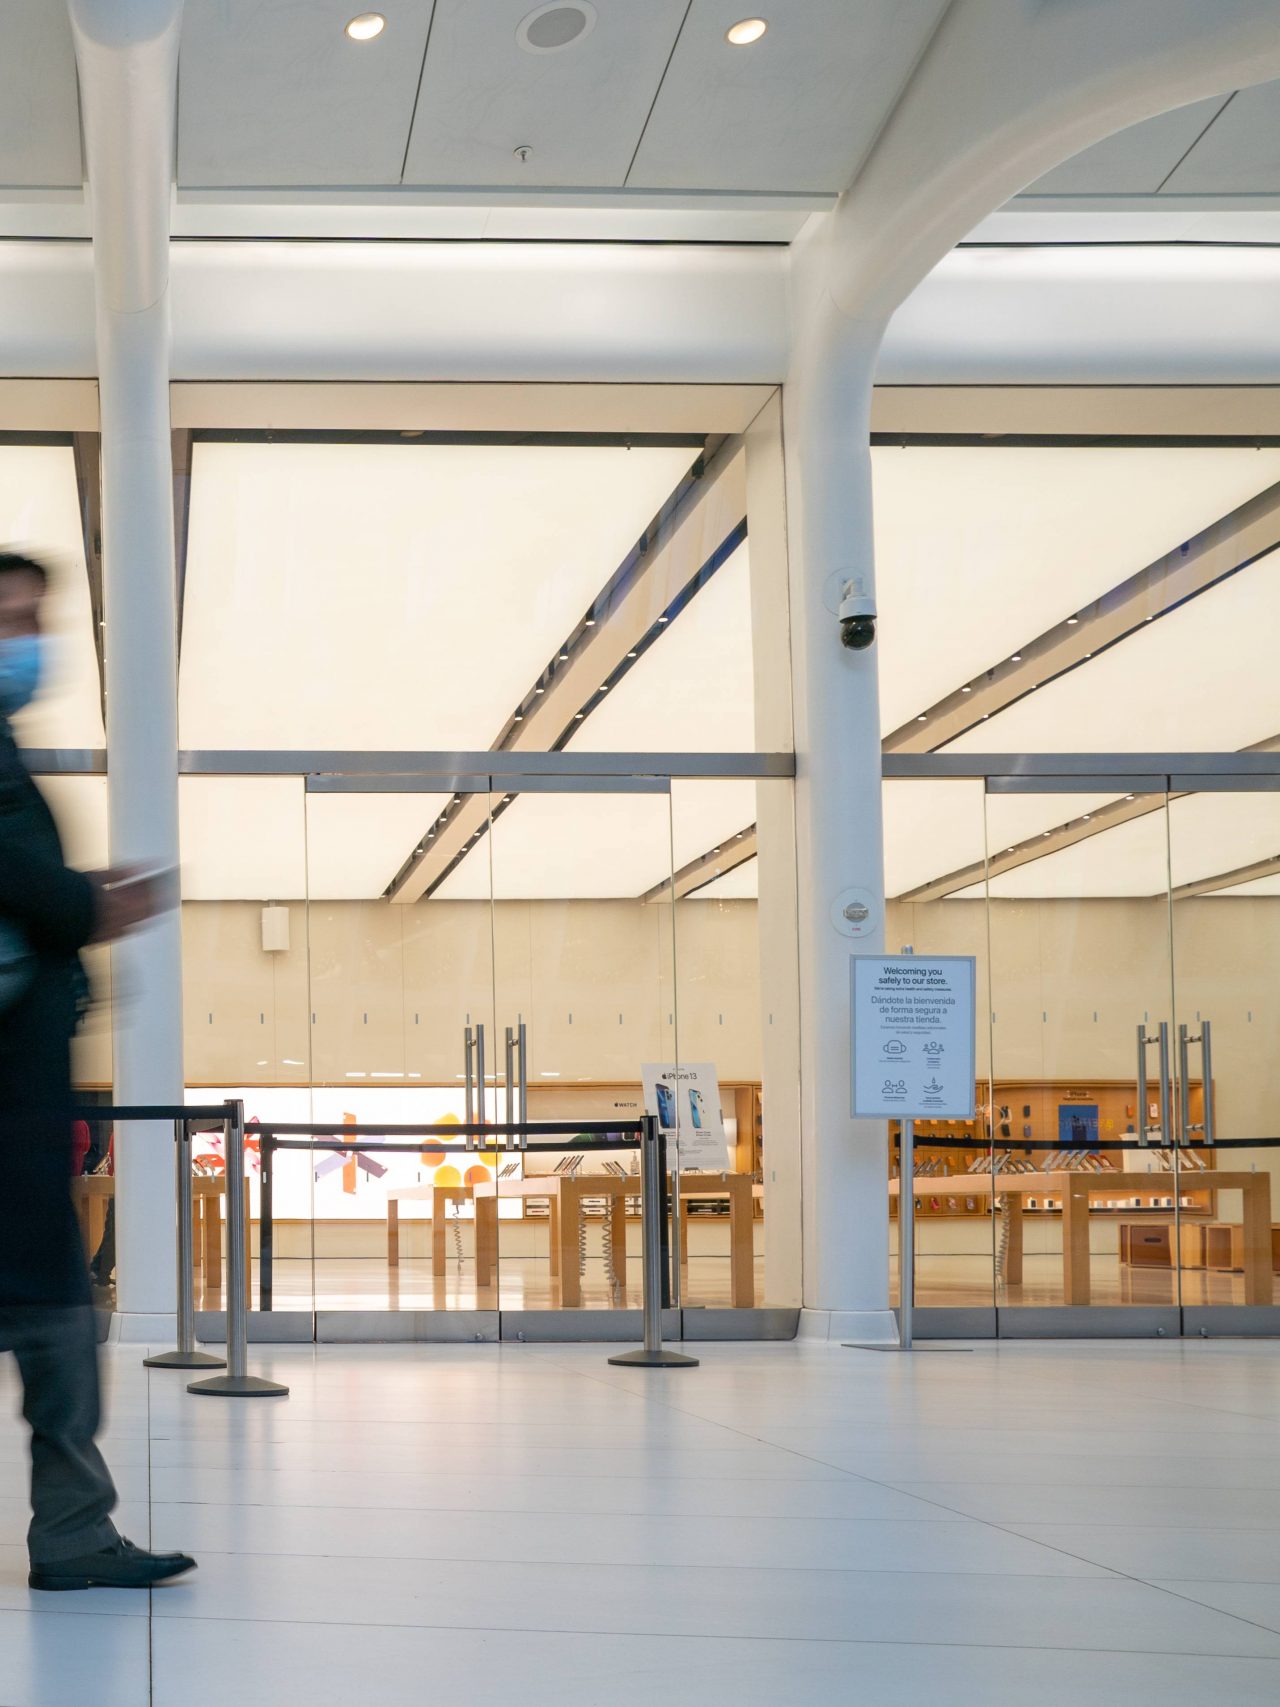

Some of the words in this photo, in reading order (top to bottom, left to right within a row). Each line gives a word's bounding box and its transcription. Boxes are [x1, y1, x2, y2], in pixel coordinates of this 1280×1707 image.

[883, 967, 926, 977] Welcoming
[928, 969, 943, 977] you
[878, 977, 901, 986] safely
[871, 996, 904, 1004] Dándote
[905, 996, 912, 1004] la
[914, 997, 956, 1005] bienvenida
[879, 1006, 890, 1014] de
[891, 1006, 914, 1014] forma
[915, 1007, 941, 1015] segura
[915, 1015, 941, 1024] tienda.
